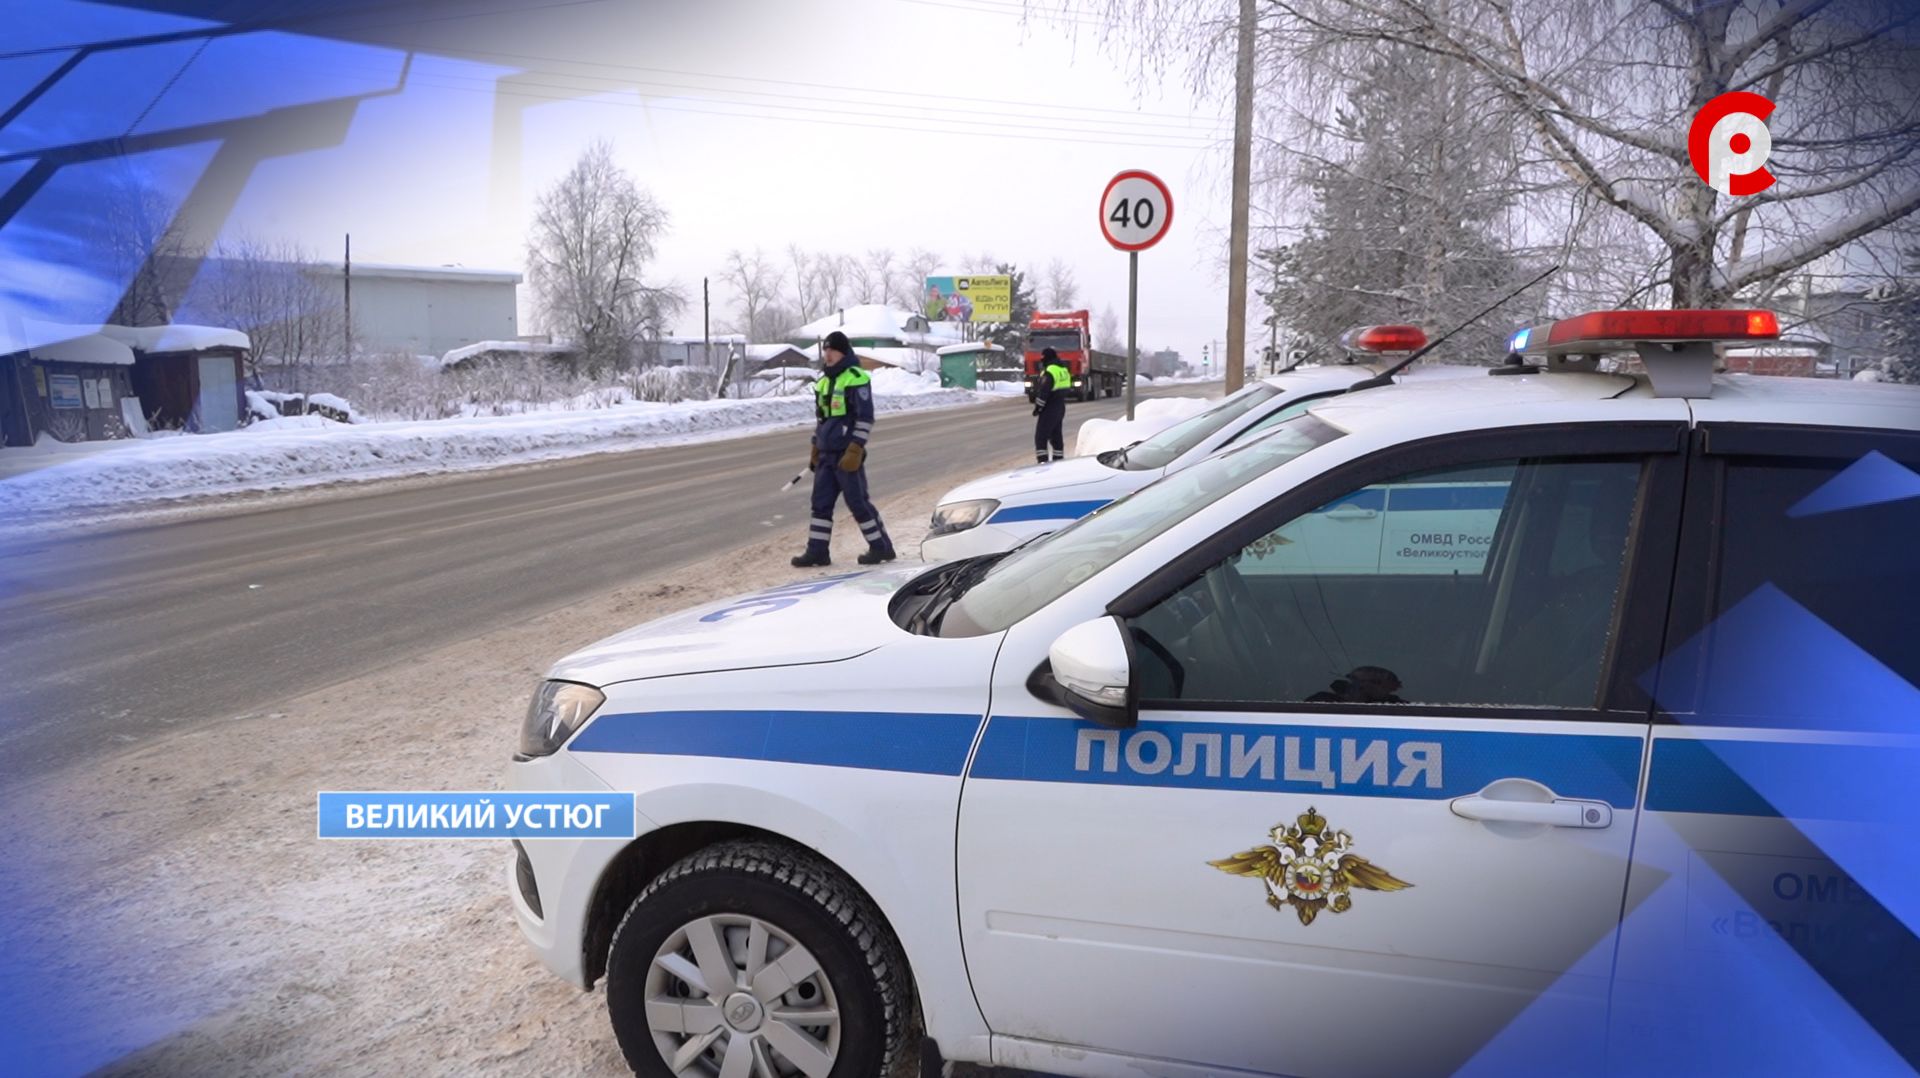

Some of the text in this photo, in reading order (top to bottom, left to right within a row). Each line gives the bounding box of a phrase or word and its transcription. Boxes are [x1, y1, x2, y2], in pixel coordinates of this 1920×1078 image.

[1110, 198, 1154, 229] 40
[1410, 533, 1492, 545] ОМВД Росс
[1396, 548, 1489, 560] «Великоустюг
[1075, 728, 1443, 789] ПОЛИЦИЯ
